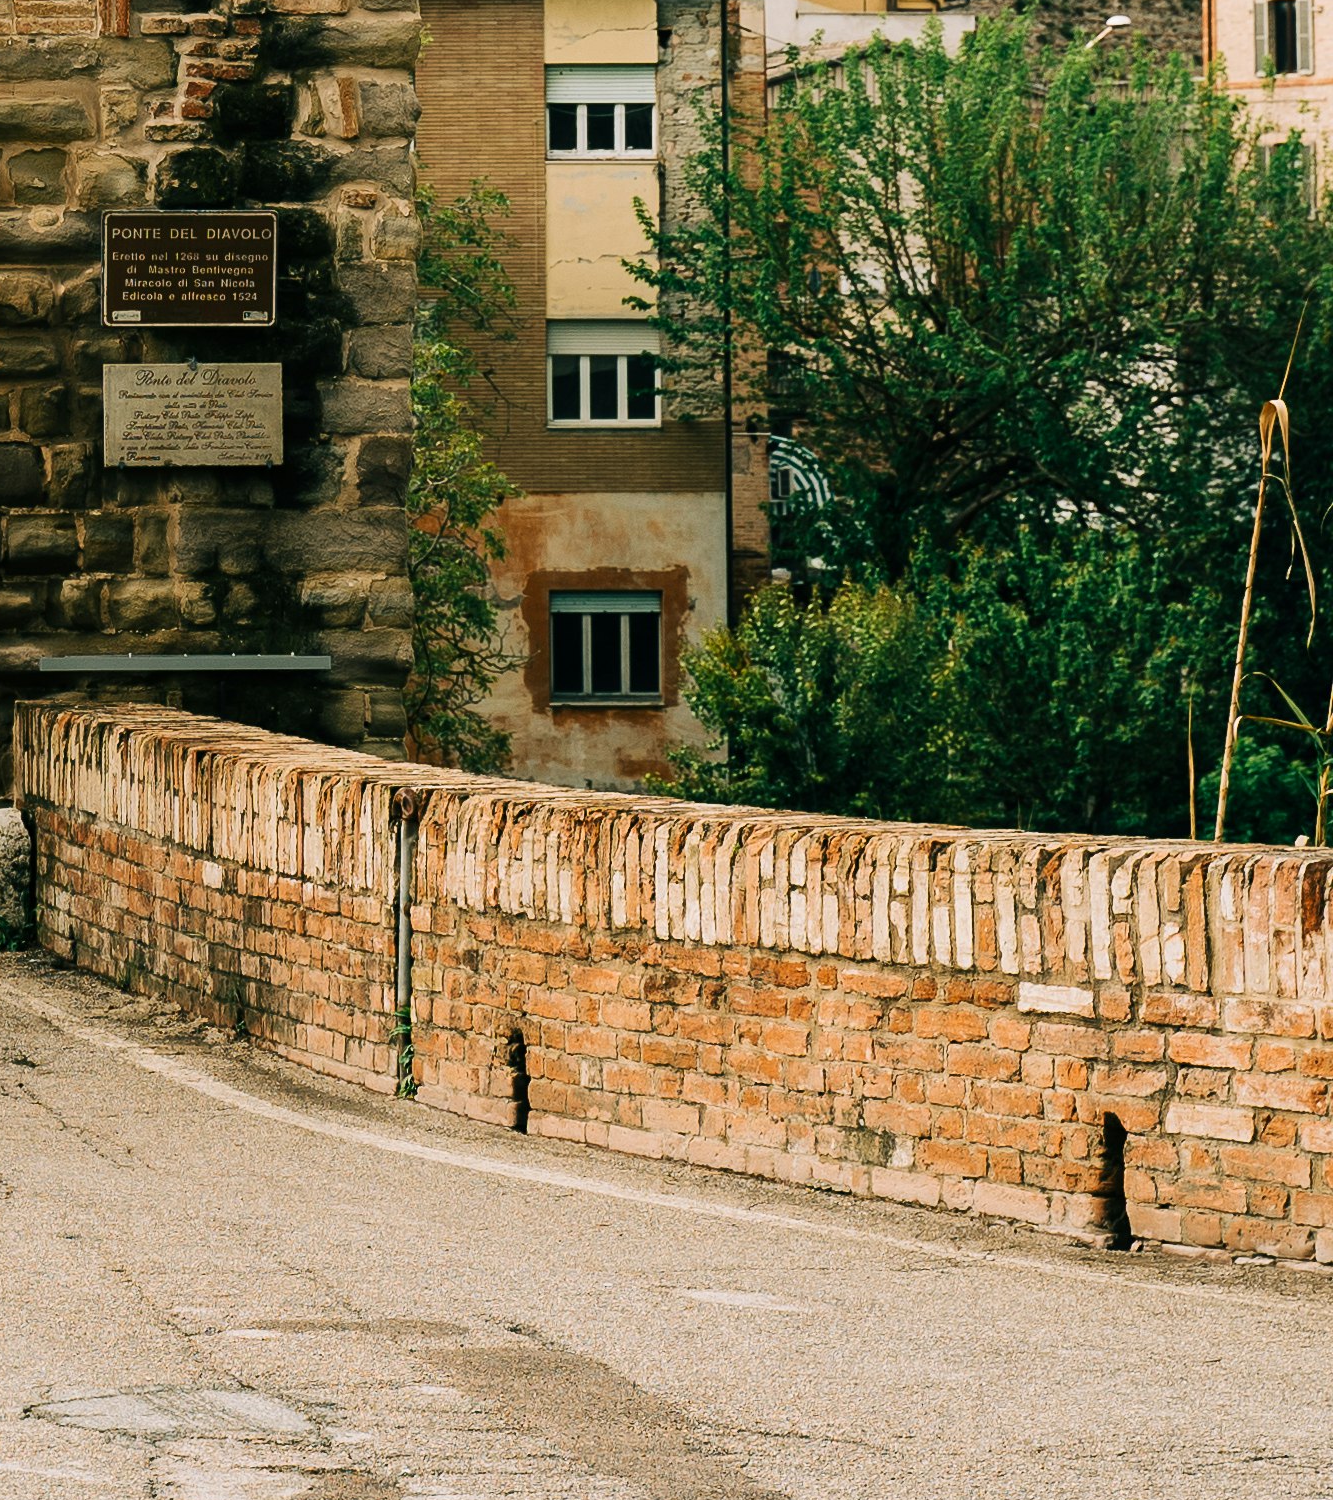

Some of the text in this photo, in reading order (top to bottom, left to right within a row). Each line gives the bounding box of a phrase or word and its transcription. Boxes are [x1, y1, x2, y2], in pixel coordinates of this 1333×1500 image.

[112, 228, 271, 240] PONTE DEL DIAVOLO
[112, 252, 145, 260] Eretto
[151, 252, 168, 260] nel
[175, 252, 199, 260] 1268
[225, 252, 268, 263] disegno
[127, 265, 254, 276] di Mastro Bentivegna
[125, 279, 255, 287] Miracolo di San Nicola
[123, 292, 162, 300] Edicola
[182, 292, 225, 300] affresco
[232, 293, 257, 301] 1524
[135, 369, 256, 386] Ponte del Diavolo
